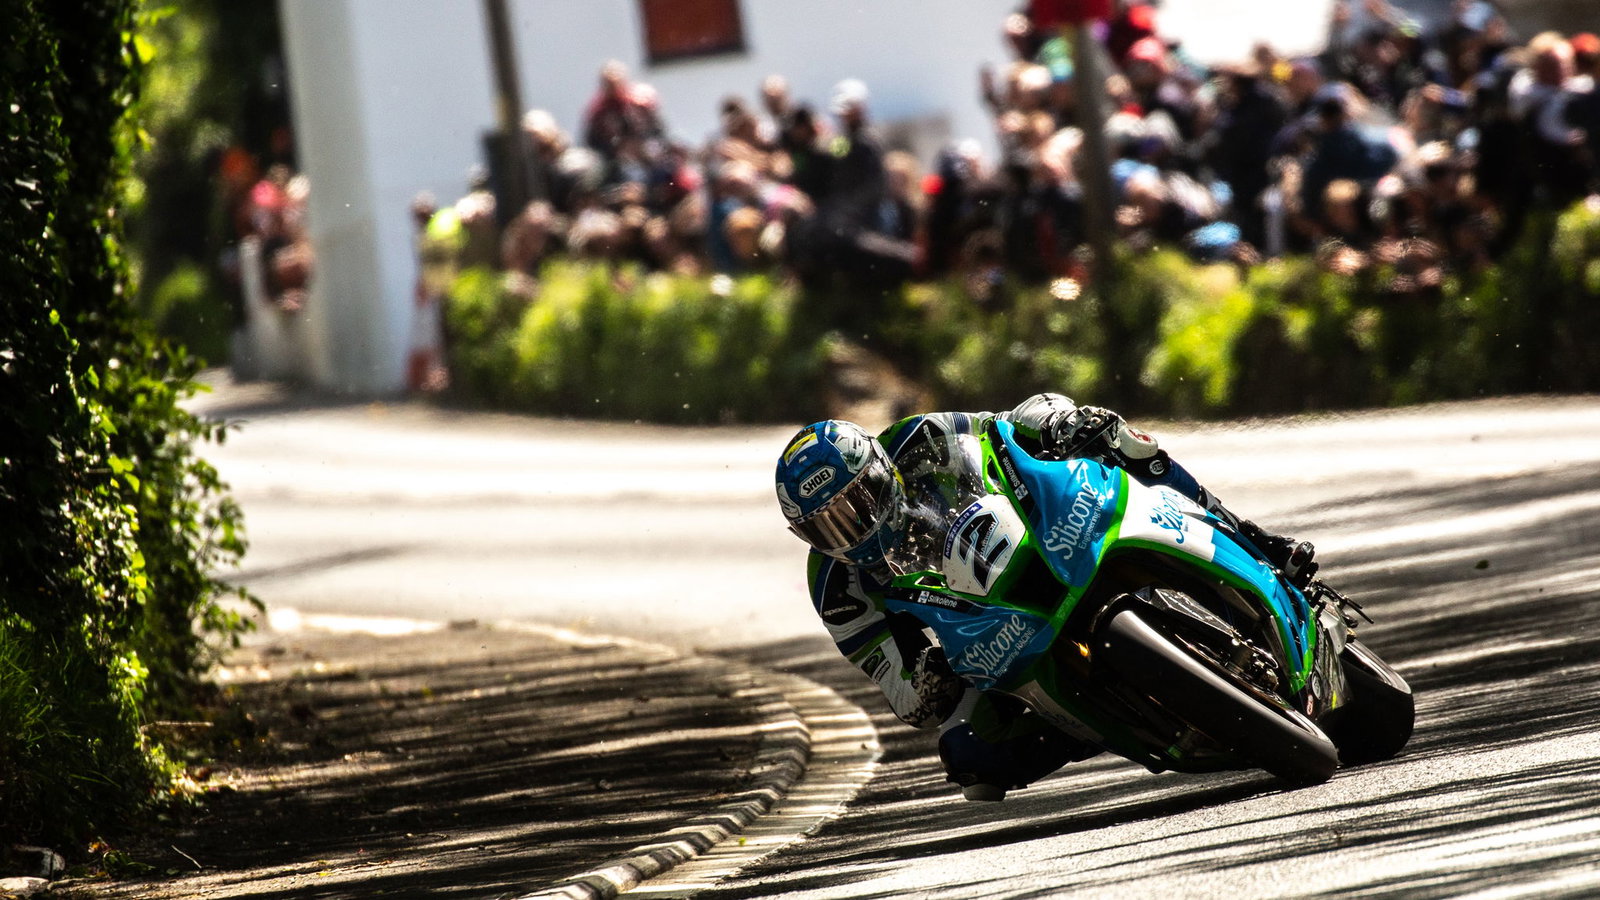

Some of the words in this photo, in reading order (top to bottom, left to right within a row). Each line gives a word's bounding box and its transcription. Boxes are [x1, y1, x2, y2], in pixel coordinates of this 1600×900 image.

[802, 468, 832, 495] SHOEI
[1003, 456, 1020, 488] Silkolene
[945, 511, 971, 557] METZELER
[1043, 482, 1099, 560] Silicone
[1078, 512, 1101, 549] Engineering
[957, 511, 1012, 593] 2
[928, 594, 958, 608] Silkolene
[964, 614, 1027, 676] Silicone
[1015, 626, 1036, 650] RACING
